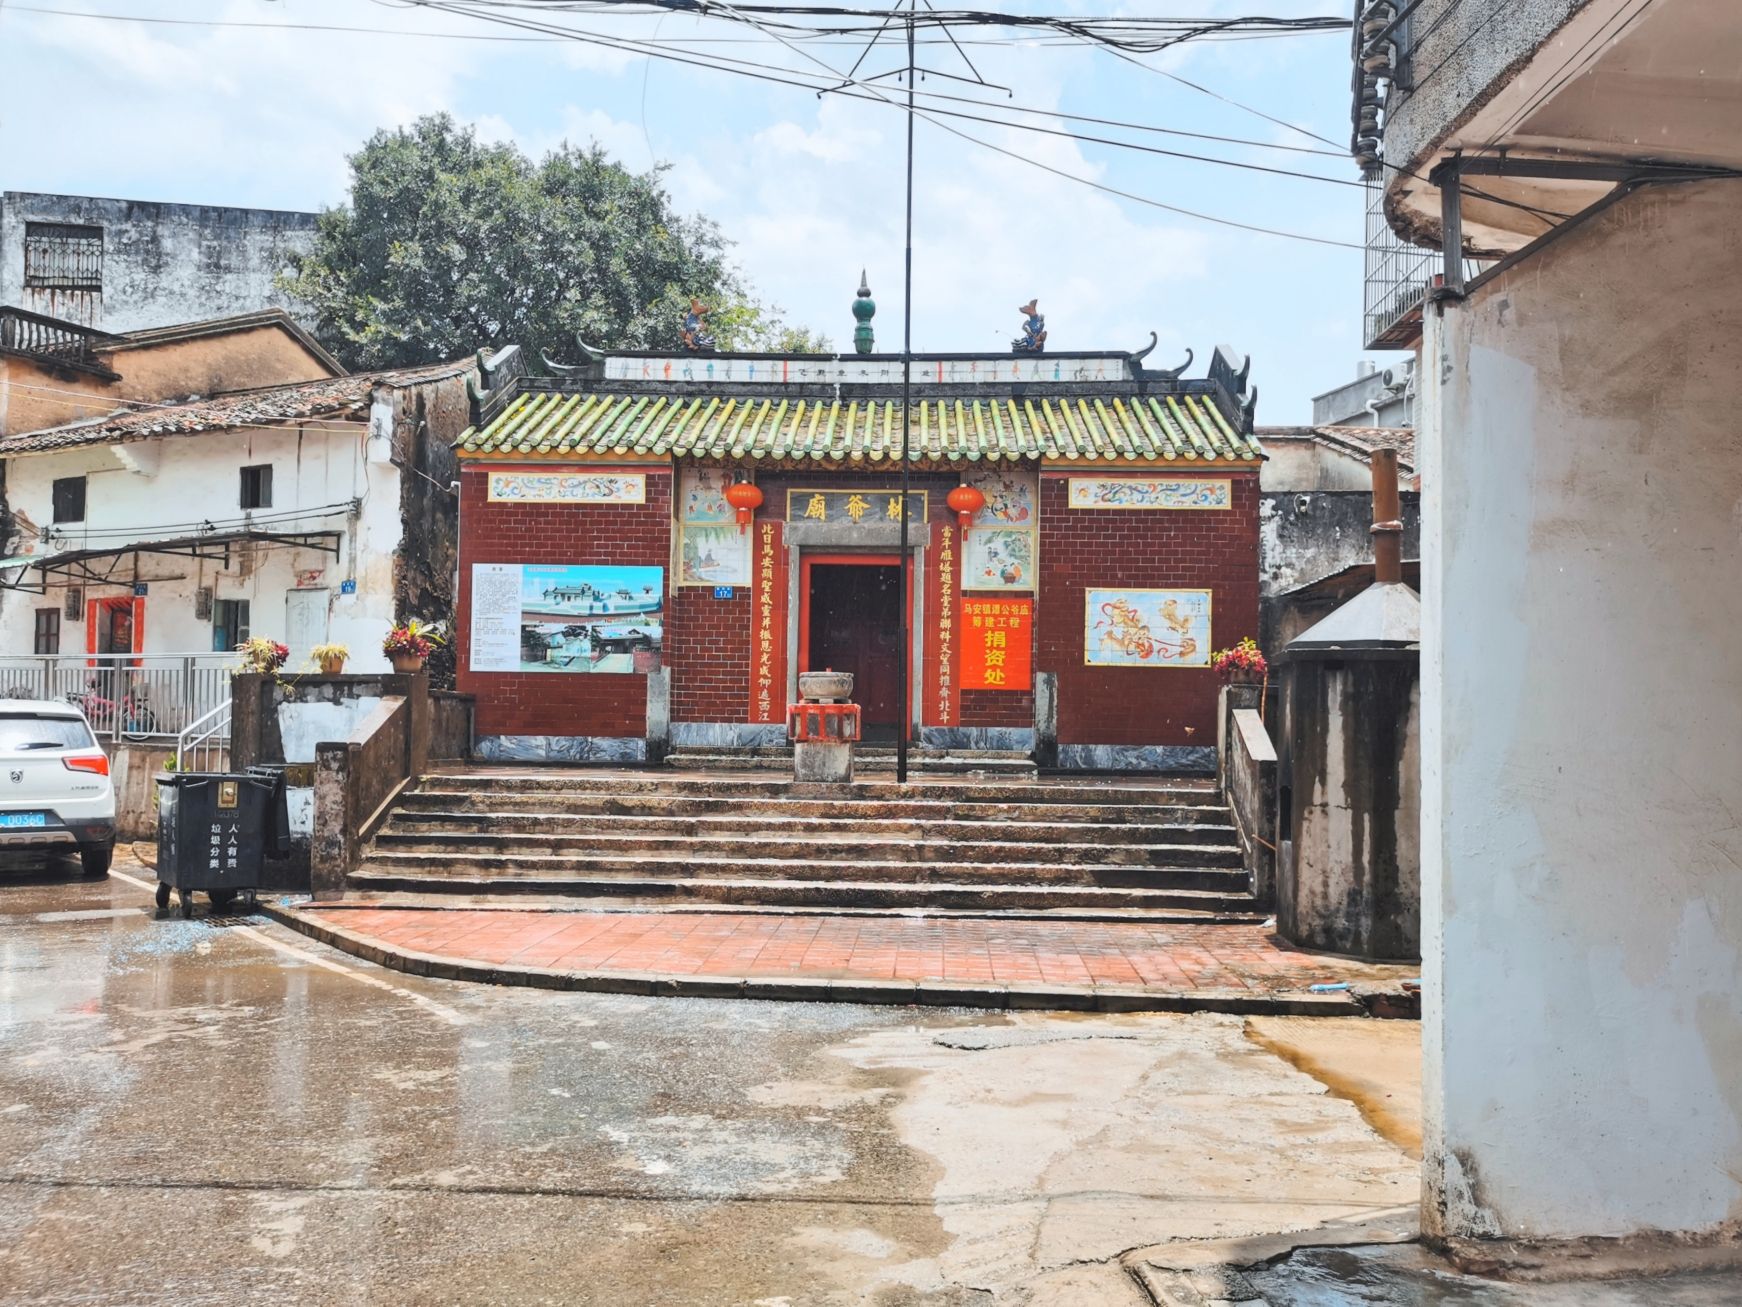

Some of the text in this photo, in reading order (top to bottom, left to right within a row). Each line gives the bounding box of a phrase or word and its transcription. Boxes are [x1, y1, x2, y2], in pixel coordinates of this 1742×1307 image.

[719, 590, 728, 598] 17
[984, 630, 1006, 685] 捐资处
[209, 823, 221, 869] 垃圾分类
